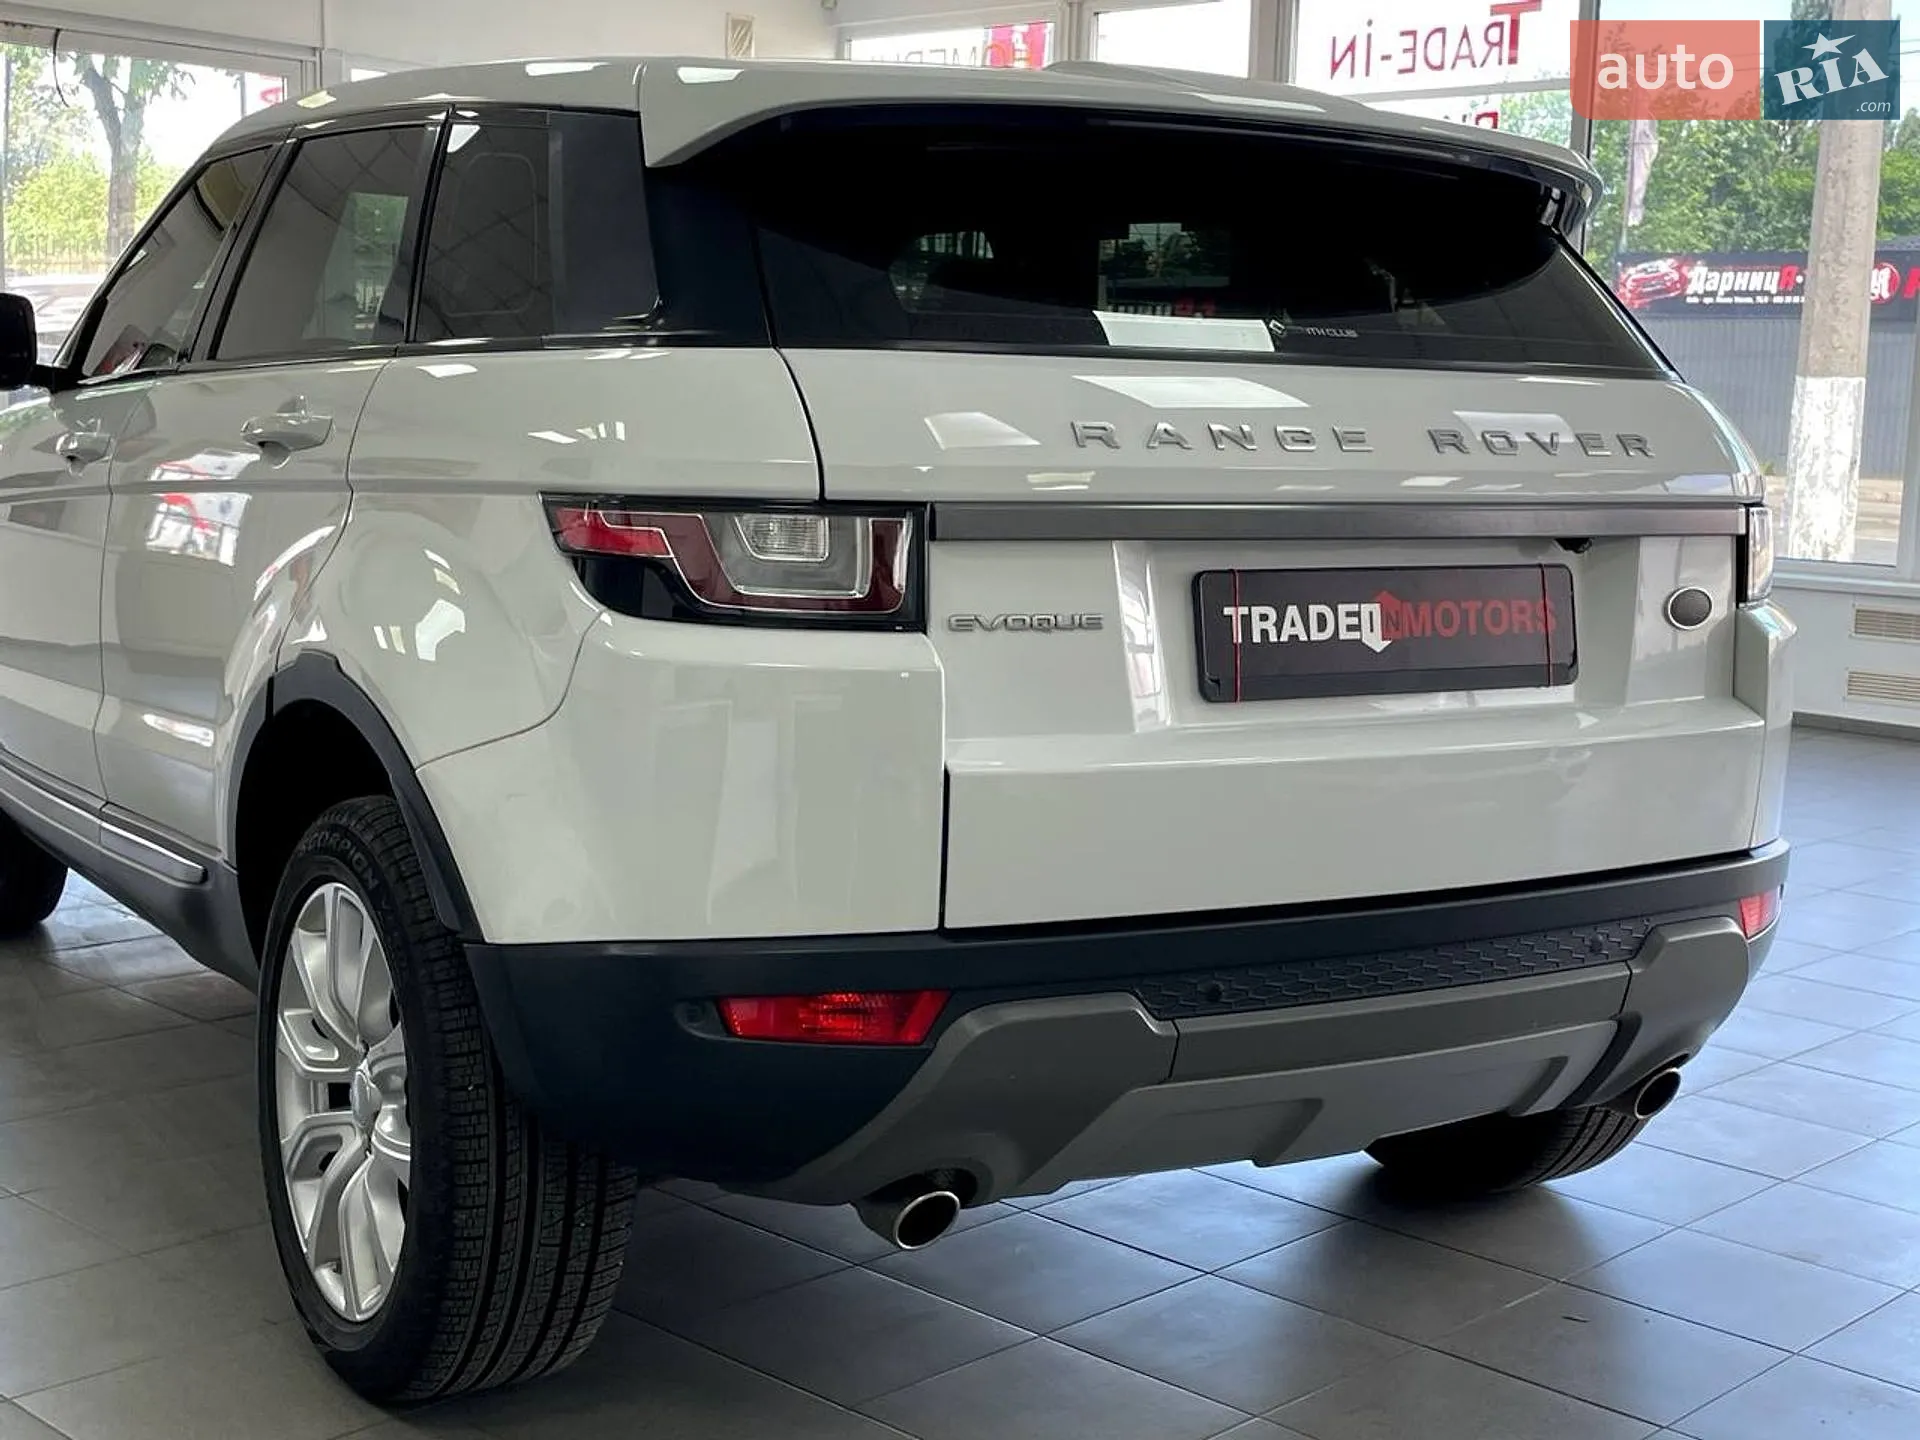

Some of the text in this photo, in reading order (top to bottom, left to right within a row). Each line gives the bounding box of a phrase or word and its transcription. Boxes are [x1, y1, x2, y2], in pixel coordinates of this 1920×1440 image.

[1070, 420, 1656, 458] RANGE ROVER
[948, 612, 1104, 634] EVOQUE
